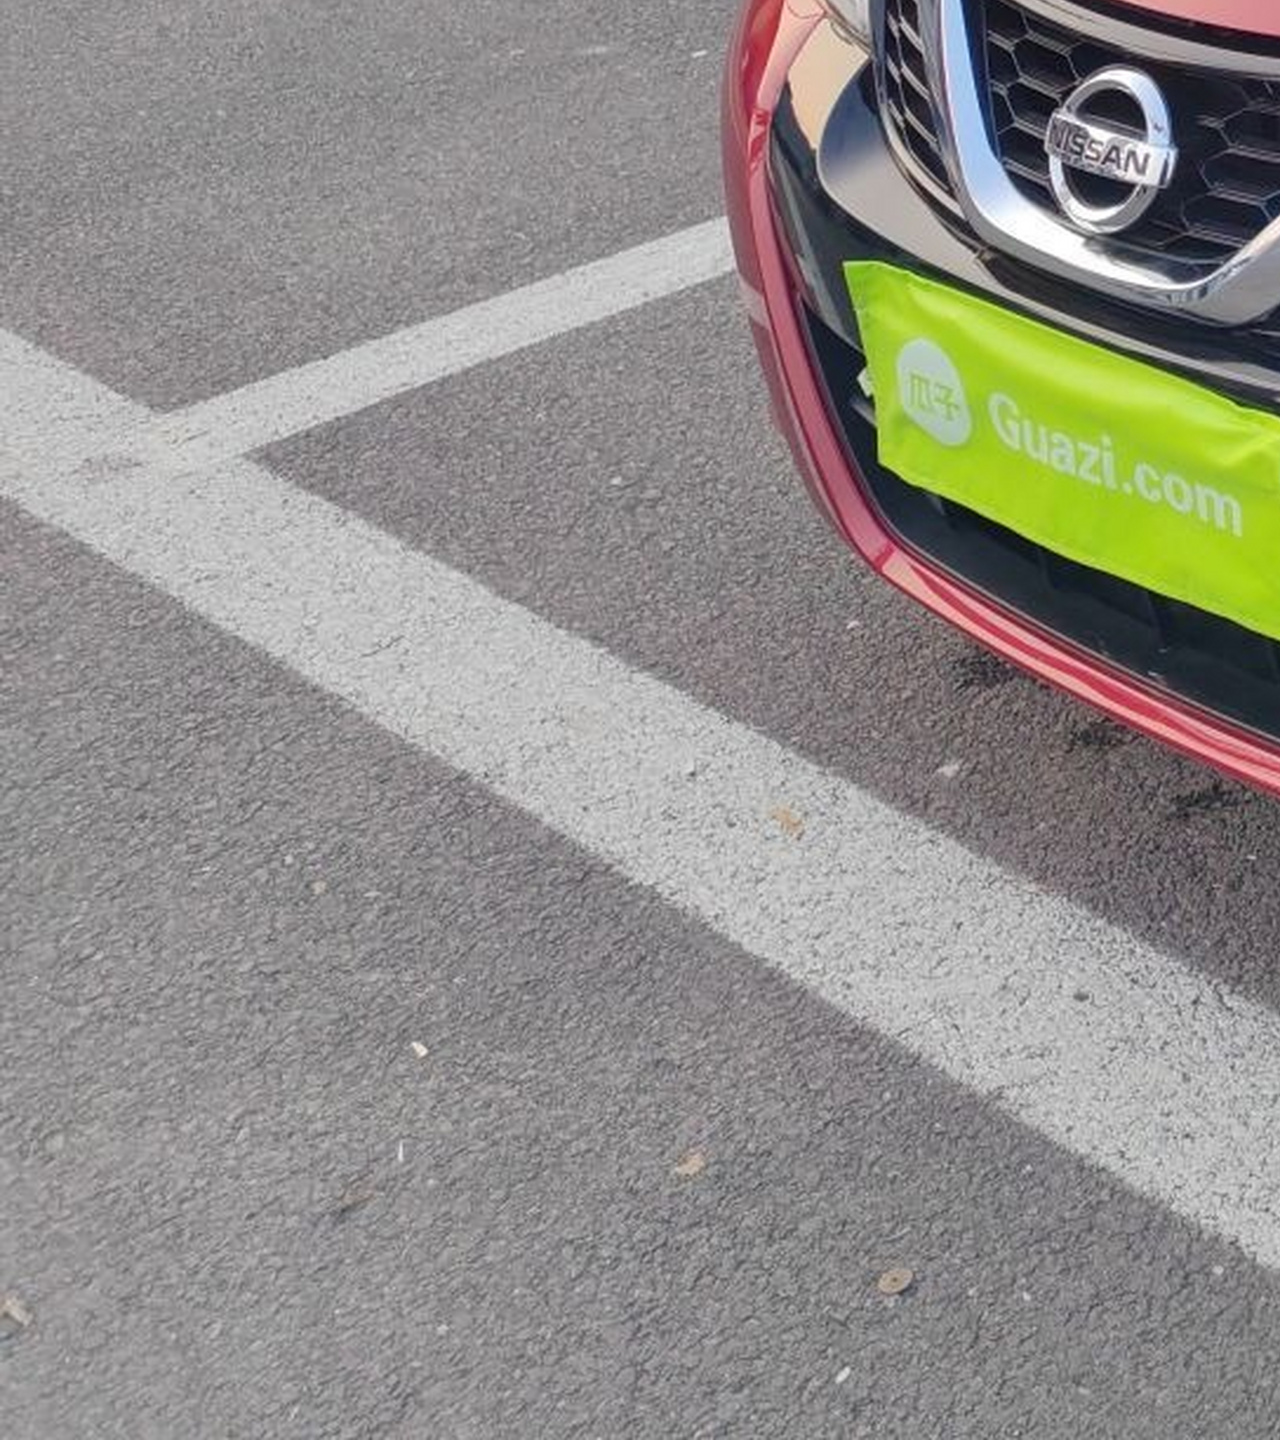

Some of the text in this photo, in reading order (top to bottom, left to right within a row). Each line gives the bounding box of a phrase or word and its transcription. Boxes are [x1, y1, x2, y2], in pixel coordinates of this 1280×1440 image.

[1051, 123, 1152, 177] NISSAN
[905, 371, 961, 423] 瓜子
[987, 391, 1244, 538] Guazi.com
